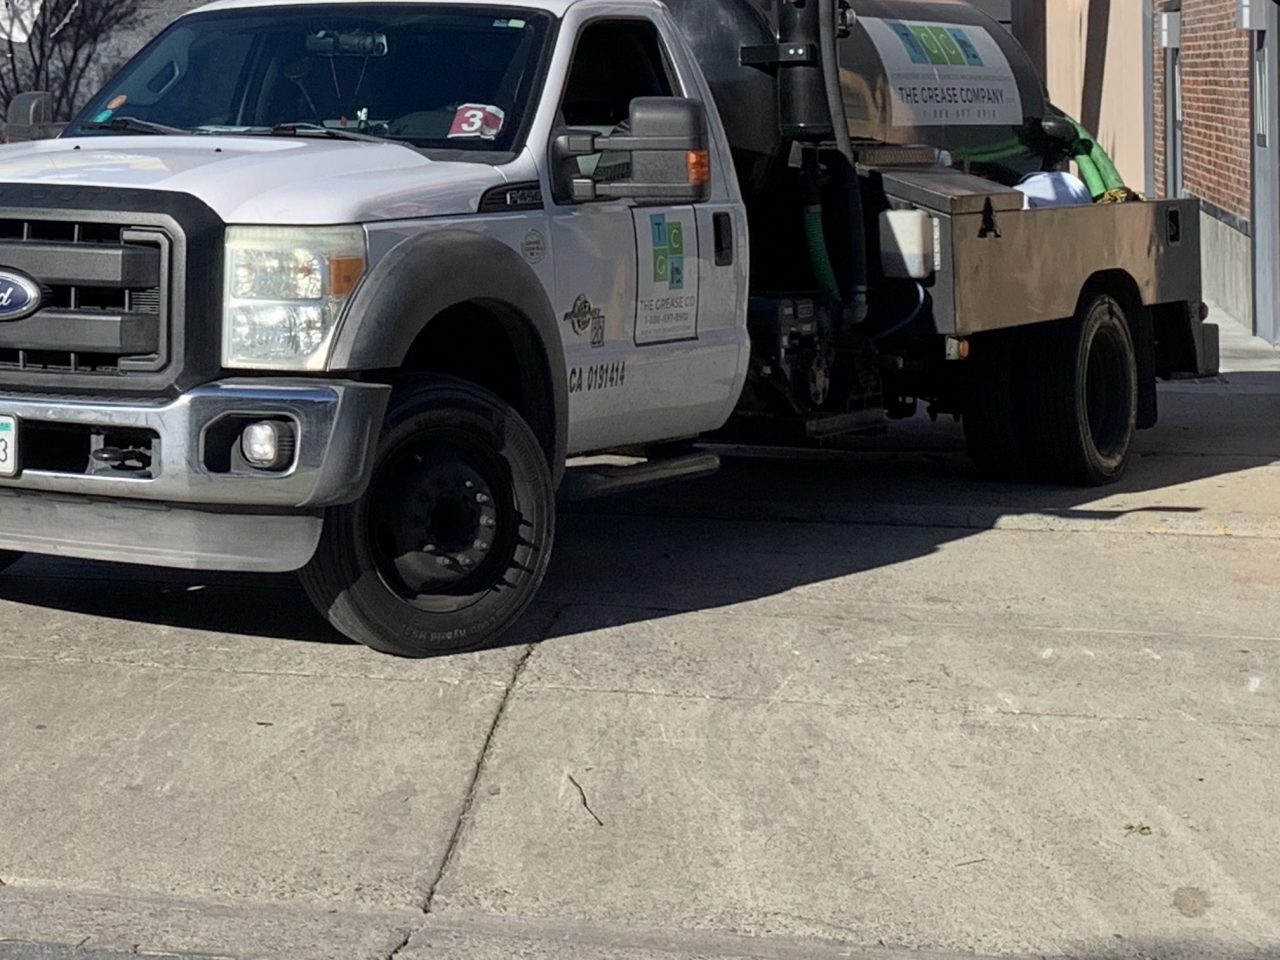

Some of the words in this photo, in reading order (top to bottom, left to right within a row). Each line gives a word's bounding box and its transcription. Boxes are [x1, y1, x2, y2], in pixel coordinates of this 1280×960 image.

[898, 87, 919, 104] THE
[921, 87, 958, 104] GREASE
[960, 87, 1004, 105] COMPANY
[461, 110, 483, 132] 3
[640, 299, 654, 312] THE
[655, 296, 684, 311] GREASE
[569, 367, 583, 394] CA
[587, 360, 626, 392] 0191414
